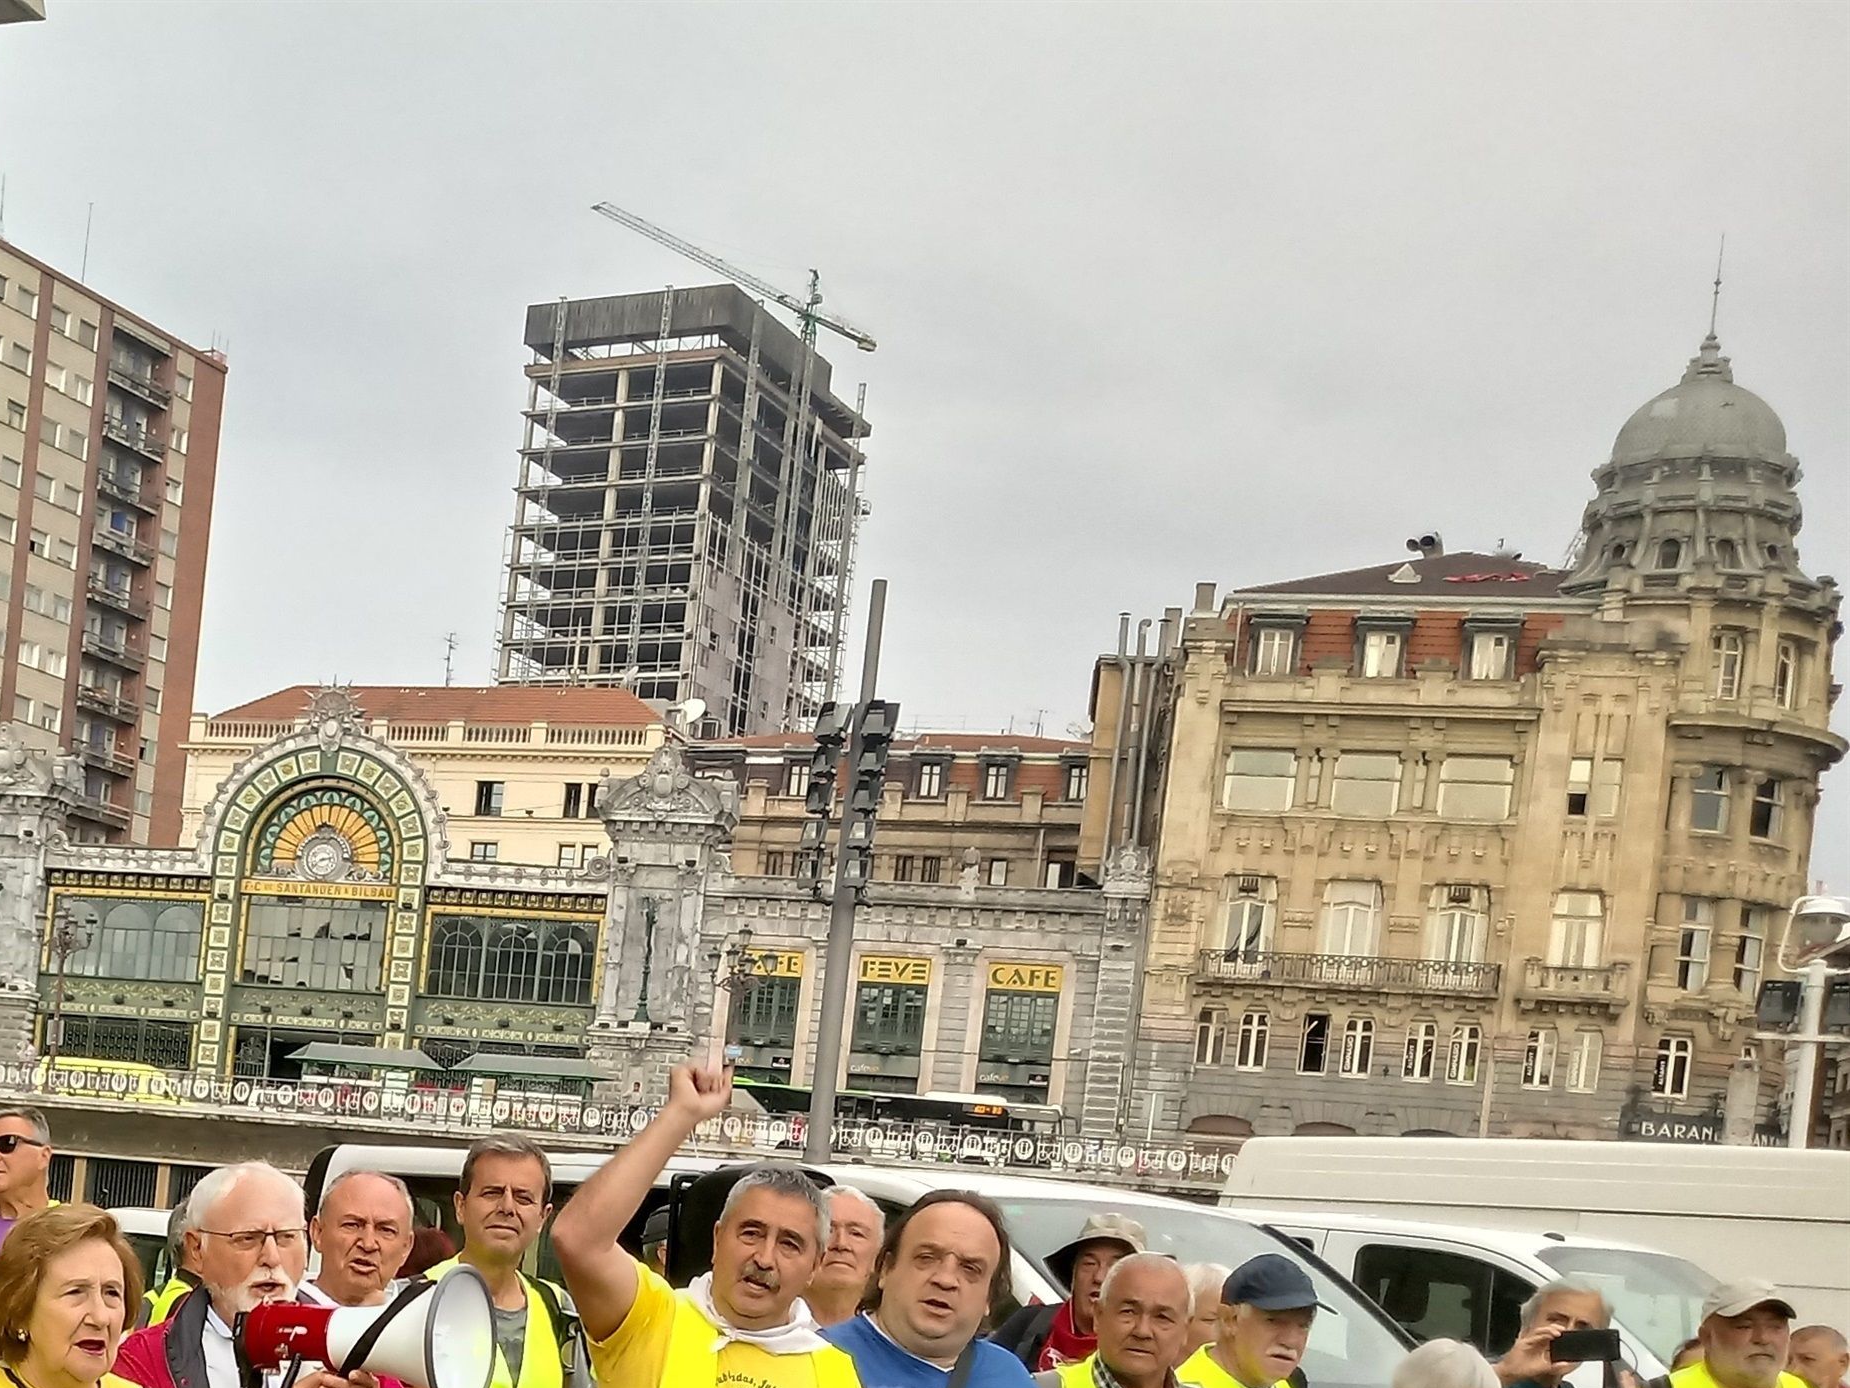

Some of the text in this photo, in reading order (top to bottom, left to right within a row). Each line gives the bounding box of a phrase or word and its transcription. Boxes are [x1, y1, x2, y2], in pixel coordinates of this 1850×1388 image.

[276, 883, 342, 896] SANTANDER
[351, 886, 393, 898] BILBAO
[750, 953, 800, 975] AFE
[861, 959, 927, 981] FEVE
[990, 966, 1058, 988] CAFE
[1641, 1120, 1719, 1143] BARAN
